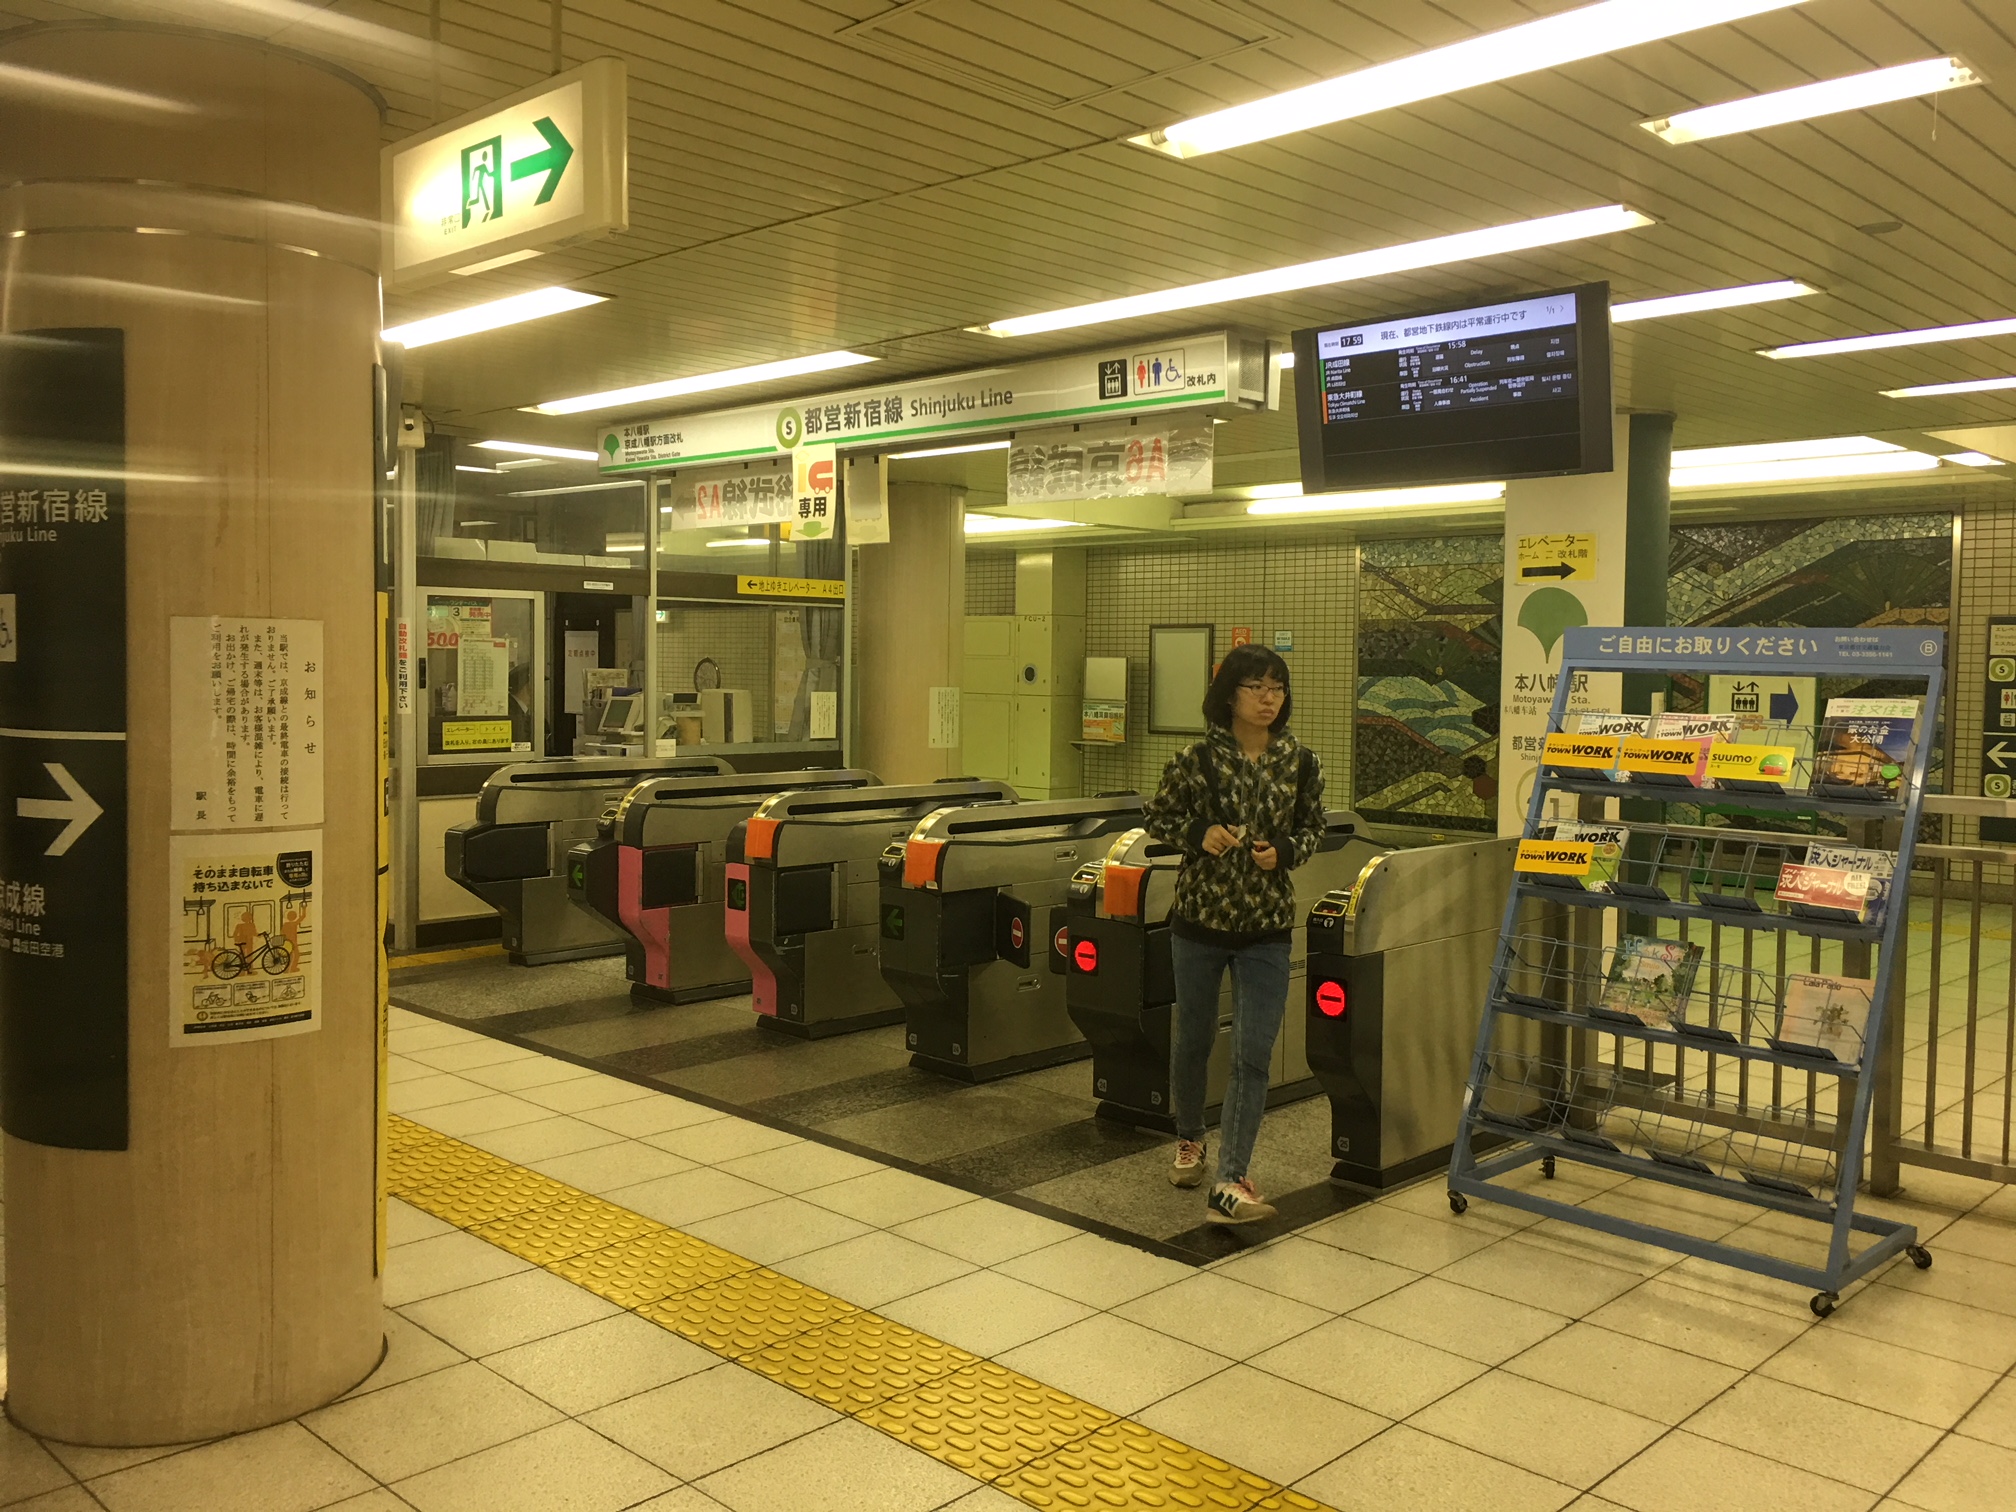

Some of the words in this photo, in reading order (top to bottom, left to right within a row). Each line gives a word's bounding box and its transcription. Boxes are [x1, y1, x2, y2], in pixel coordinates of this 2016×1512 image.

[444, 225, 456, 236] EXIT
[1448, 340, 1467, 350] 15:58
[1464, 360, 1490, 368] Obstruction
[1186, 373, 1216, 388] 改札内
[1450, 375, 1468, 384] 16:41
[910, 392, 976, 418] Shinjuku
[980, 388, 1014, 408] Line
[804, 395, 904, 436] 都営新宿線
[624, 424, 650, 438] 本八幡駅
[785, 420, 793, 436] S
[624, 432, 684, 450] 京成八幡駅方面改札
[798, 496, 828, 519] 専用
[27, 526, 58, 542] Line
[1518, 534, 1589, 549] エレベーター
[1518, 552, 1539, 560] ホーム
[1557, 548, 1588, 559] 改札階
[759, 580, 817, 594] 地上ゆきエレベーター
[452, 607, 460, 617] 3
[427, 632, 459, 647] 500
[1599, 634, 1818, 657] ご自由にお取りください
[1924, 643, 1934, 653] B
[398, 622, 408, 709] 自動改札機をご利用下さい
[304, 660, 317, 754] お知らせ
[1571, 695, 1591, 705] Sta.
[1851, 703, 1916, 716] 注文住宅
[1599, 721, 1645, 735] WORK
[1682, 719, 1731, 735] WORK
[1847, 725, 1890, 735] 家のお金
[1546, 746, 1571, 754] TOWN
[1571, 744, 1614, 759] WORK
[1623, 751, 1650, 760] TOWN
[1650, 749, 1695, 765] WORK
[1711, 753, 1753, 764] suumo
[195, 791, 208, 821] 駅長
[1574, 830, 1621, 843] WORK
[1520, 853, 1545, 861] TOWN
[1545, 851, 1588, 865] WORK
[1810, 850, 1873, 870] 求人ジャーナル
[193, 865, 274, 880] そのまま自転車
[193, 879, 274, 893] 持ち込まないで
[1779, 874, 1844, 895] 求人ジャーナル
[16, 917, 41, 936] Line
[1223, 1193, 1239, 1211] N
